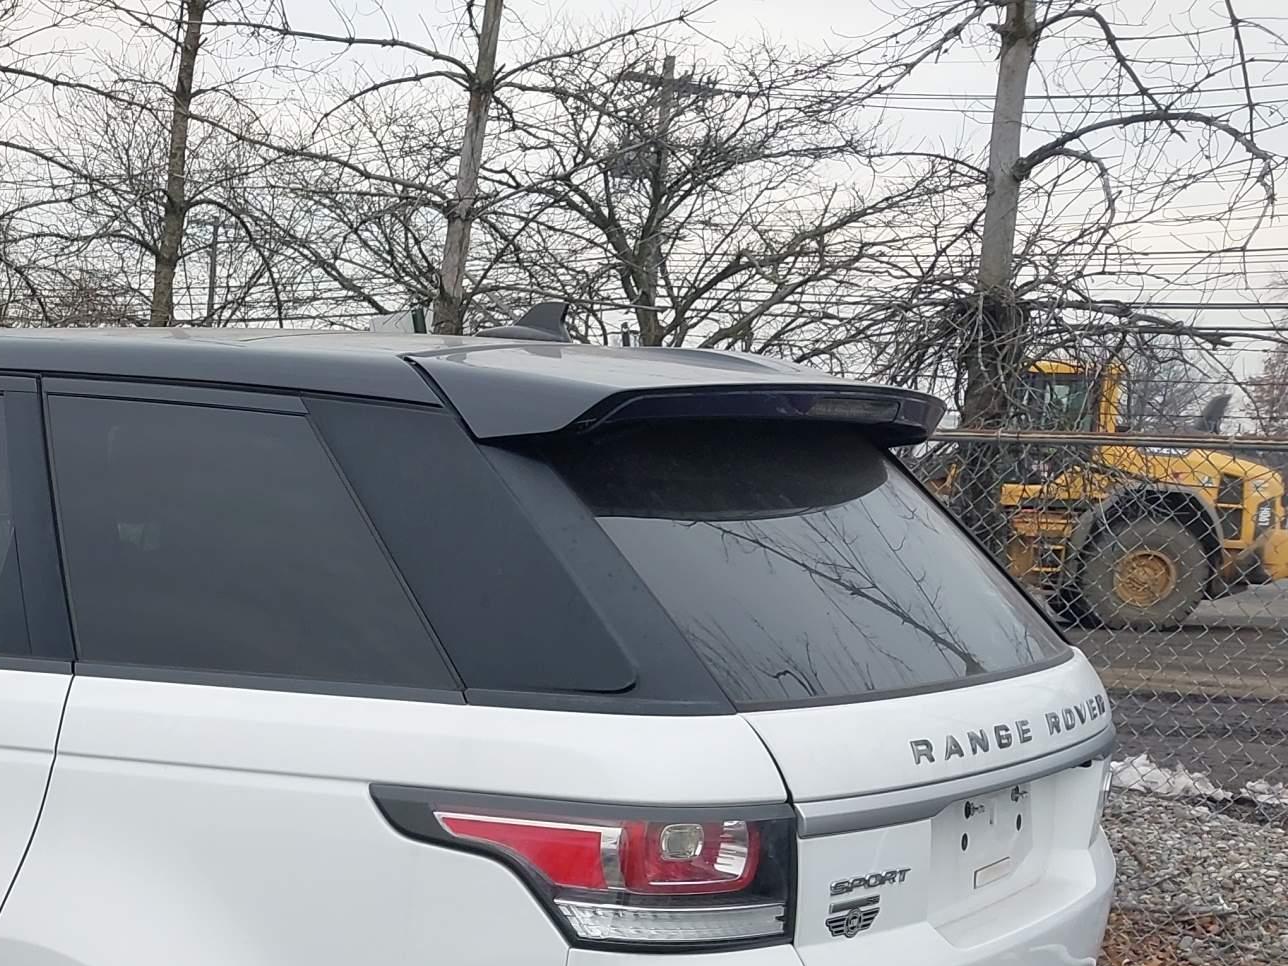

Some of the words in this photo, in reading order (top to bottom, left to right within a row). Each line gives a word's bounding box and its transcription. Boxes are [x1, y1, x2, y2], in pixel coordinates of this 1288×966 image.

[910, 720, 1033, 765] RANGE
[1045, 694, 1107, 736] ROVER
[830, 867, 912, 896] SPORT
